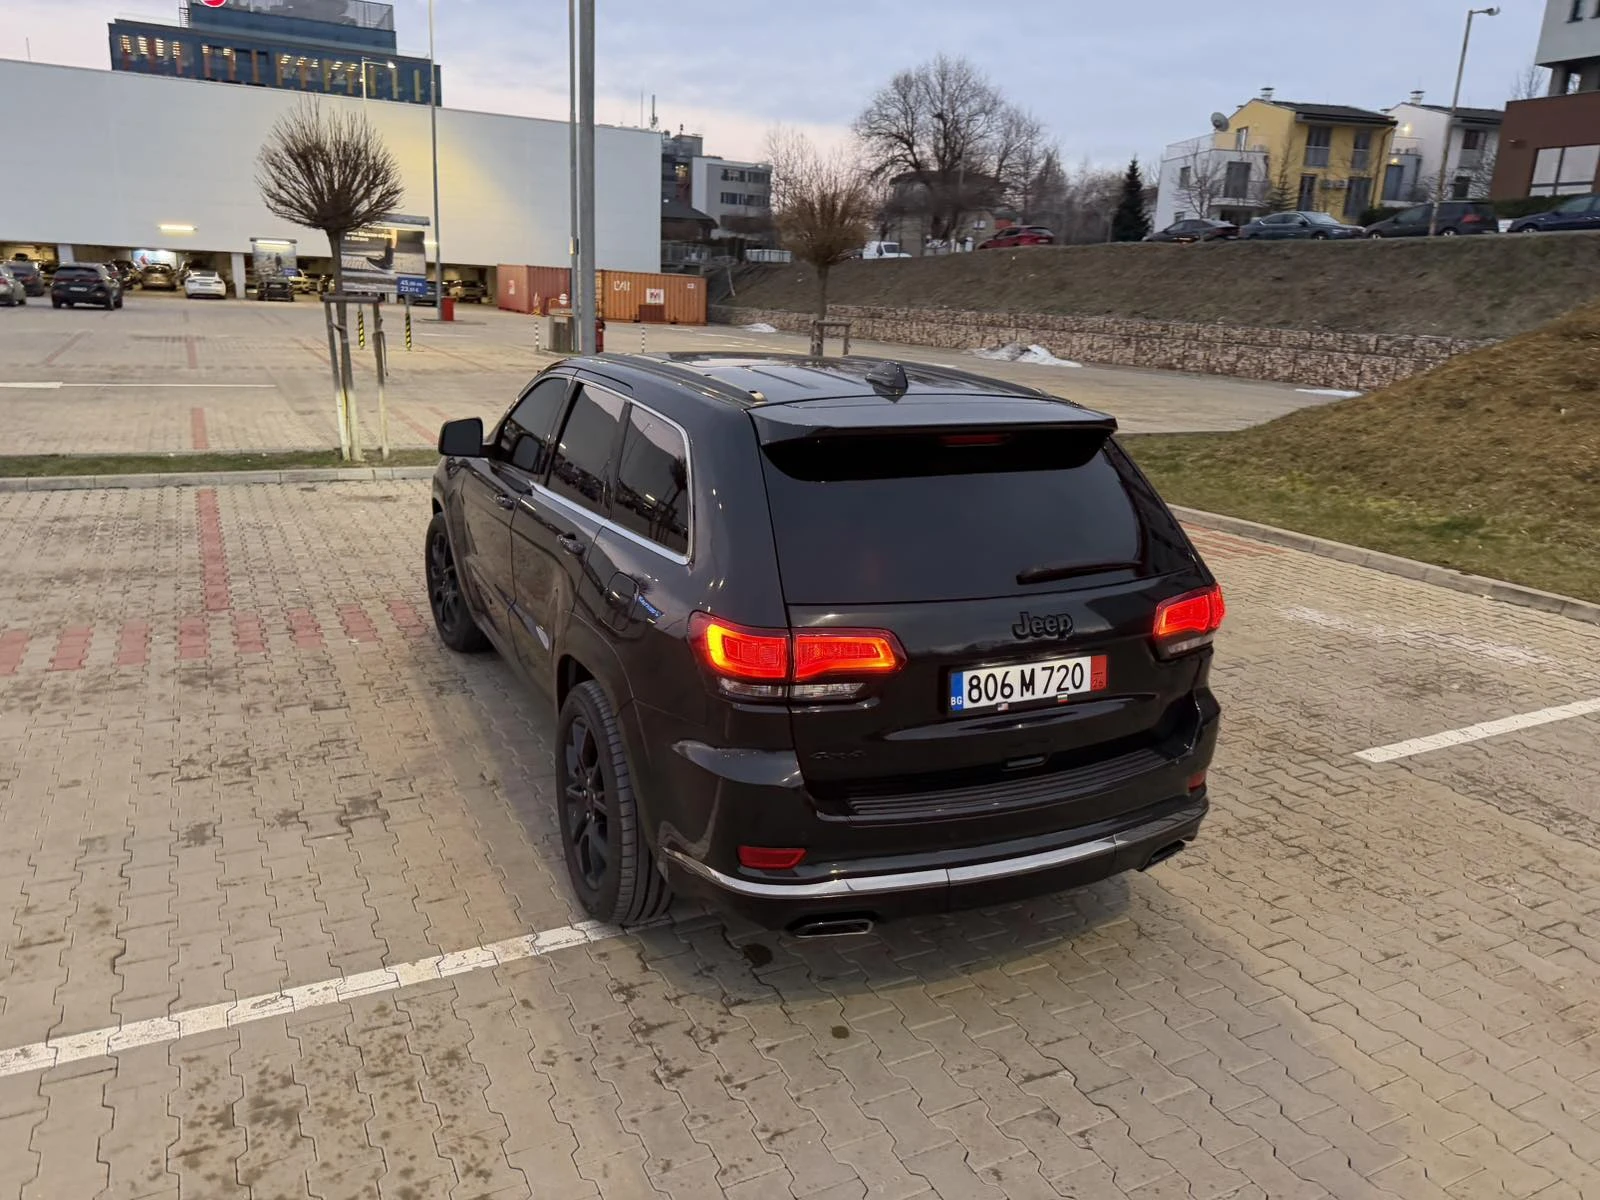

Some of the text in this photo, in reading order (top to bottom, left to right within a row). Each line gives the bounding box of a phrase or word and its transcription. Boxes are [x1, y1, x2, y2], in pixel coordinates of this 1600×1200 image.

[1012, 611, 1073, 640] Jeep
[967, 662, 1084, 704] 806 M 720
[951, 696, 963, 706] BG
